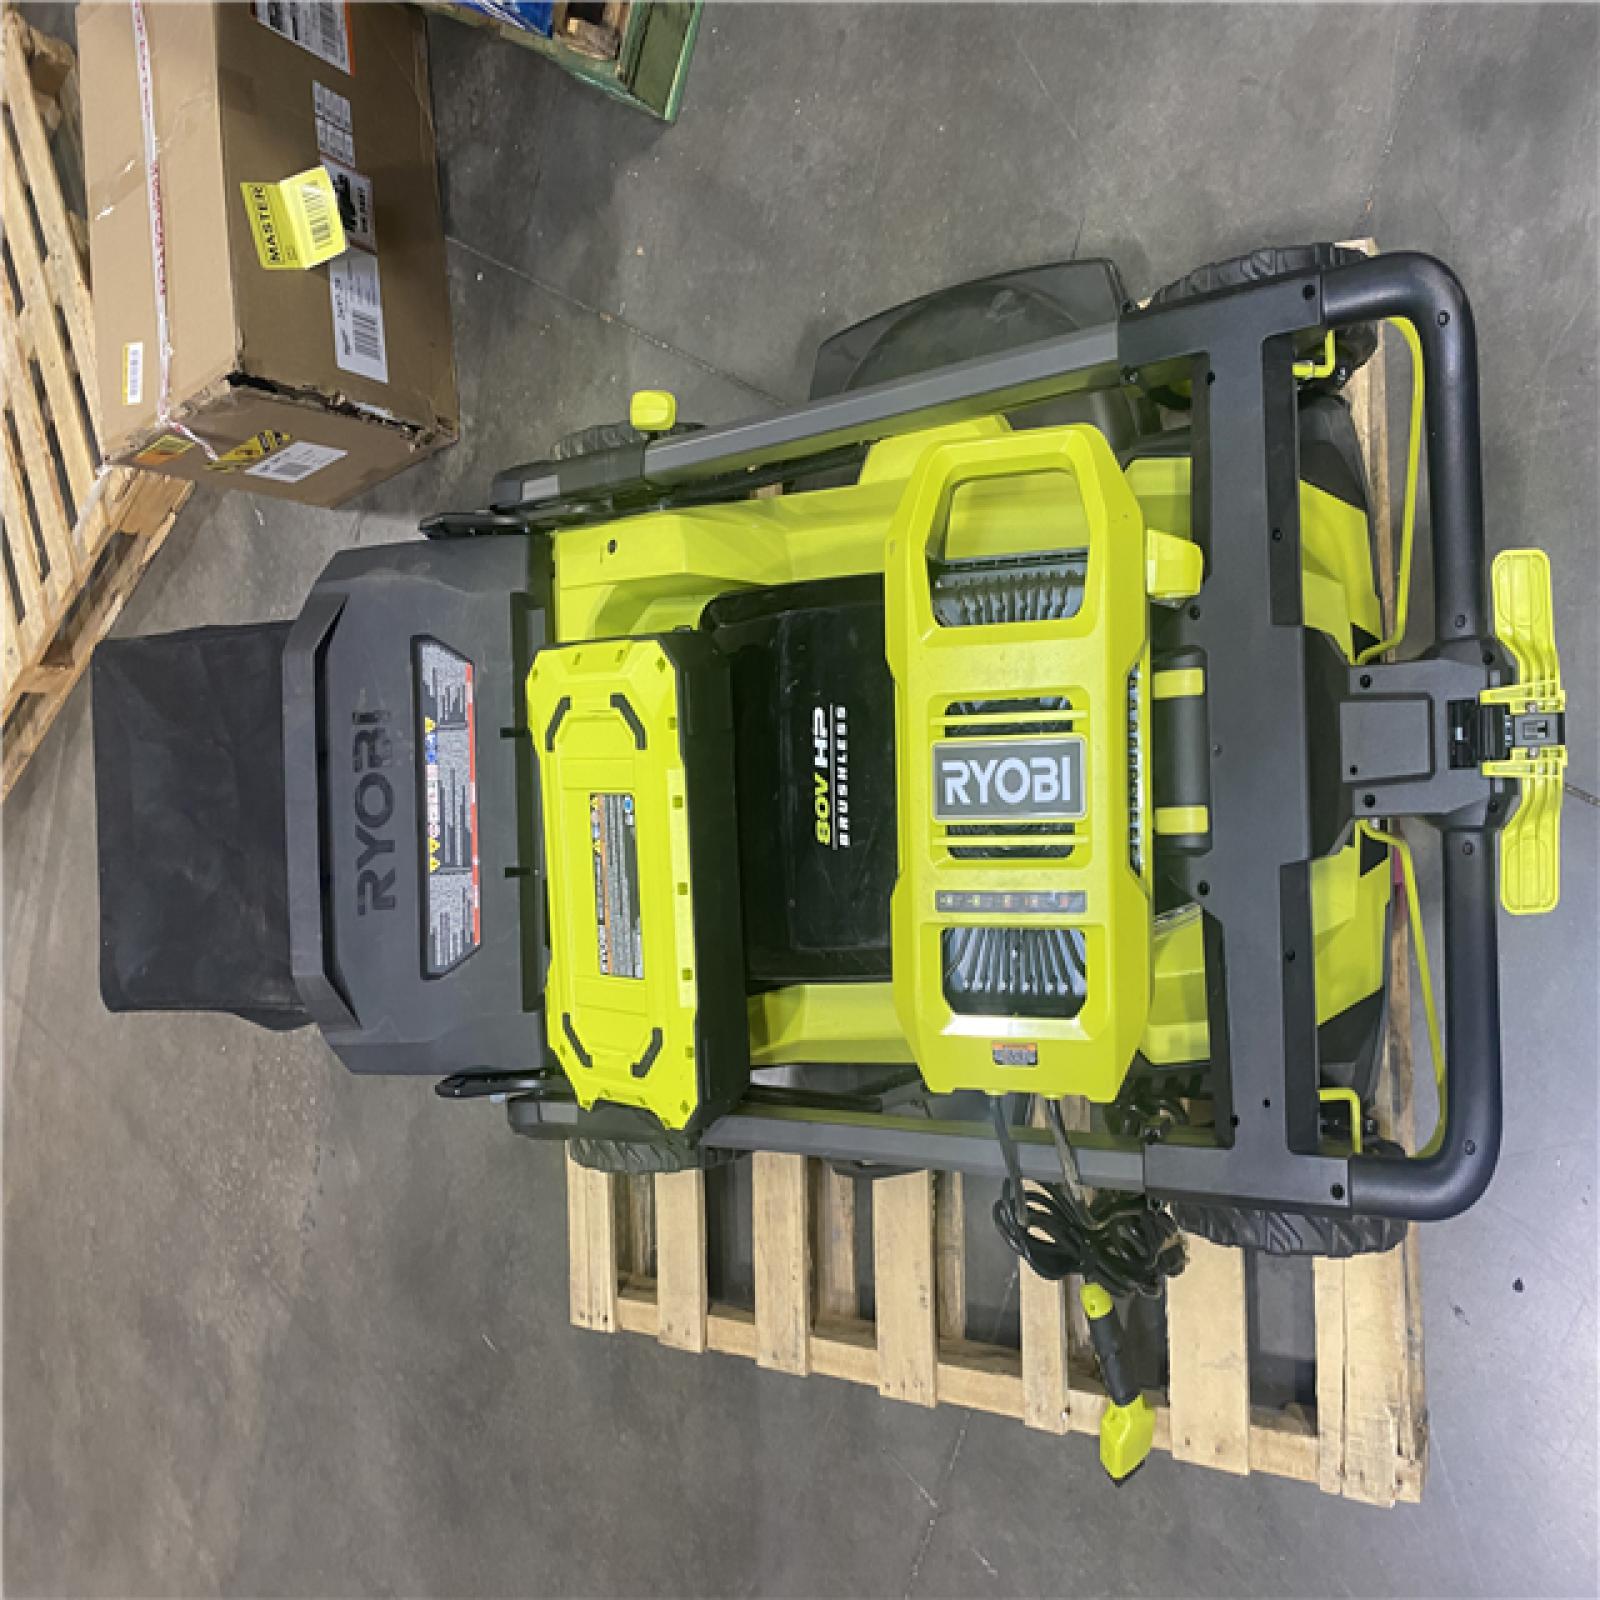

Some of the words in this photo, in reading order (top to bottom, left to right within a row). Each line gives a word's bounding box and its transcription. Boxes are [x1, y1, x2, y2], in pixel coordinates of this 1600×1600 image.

[252, 186, 281, 261] MASTER
[812, 706, 829, 769] HP
[354, 711, 396, 915] RYOBI
[814, 772, 831, 846] 80V
[835, 706, 849, 847] BRUSHLESS
[942, 757, 1071, 805] RYOBI
